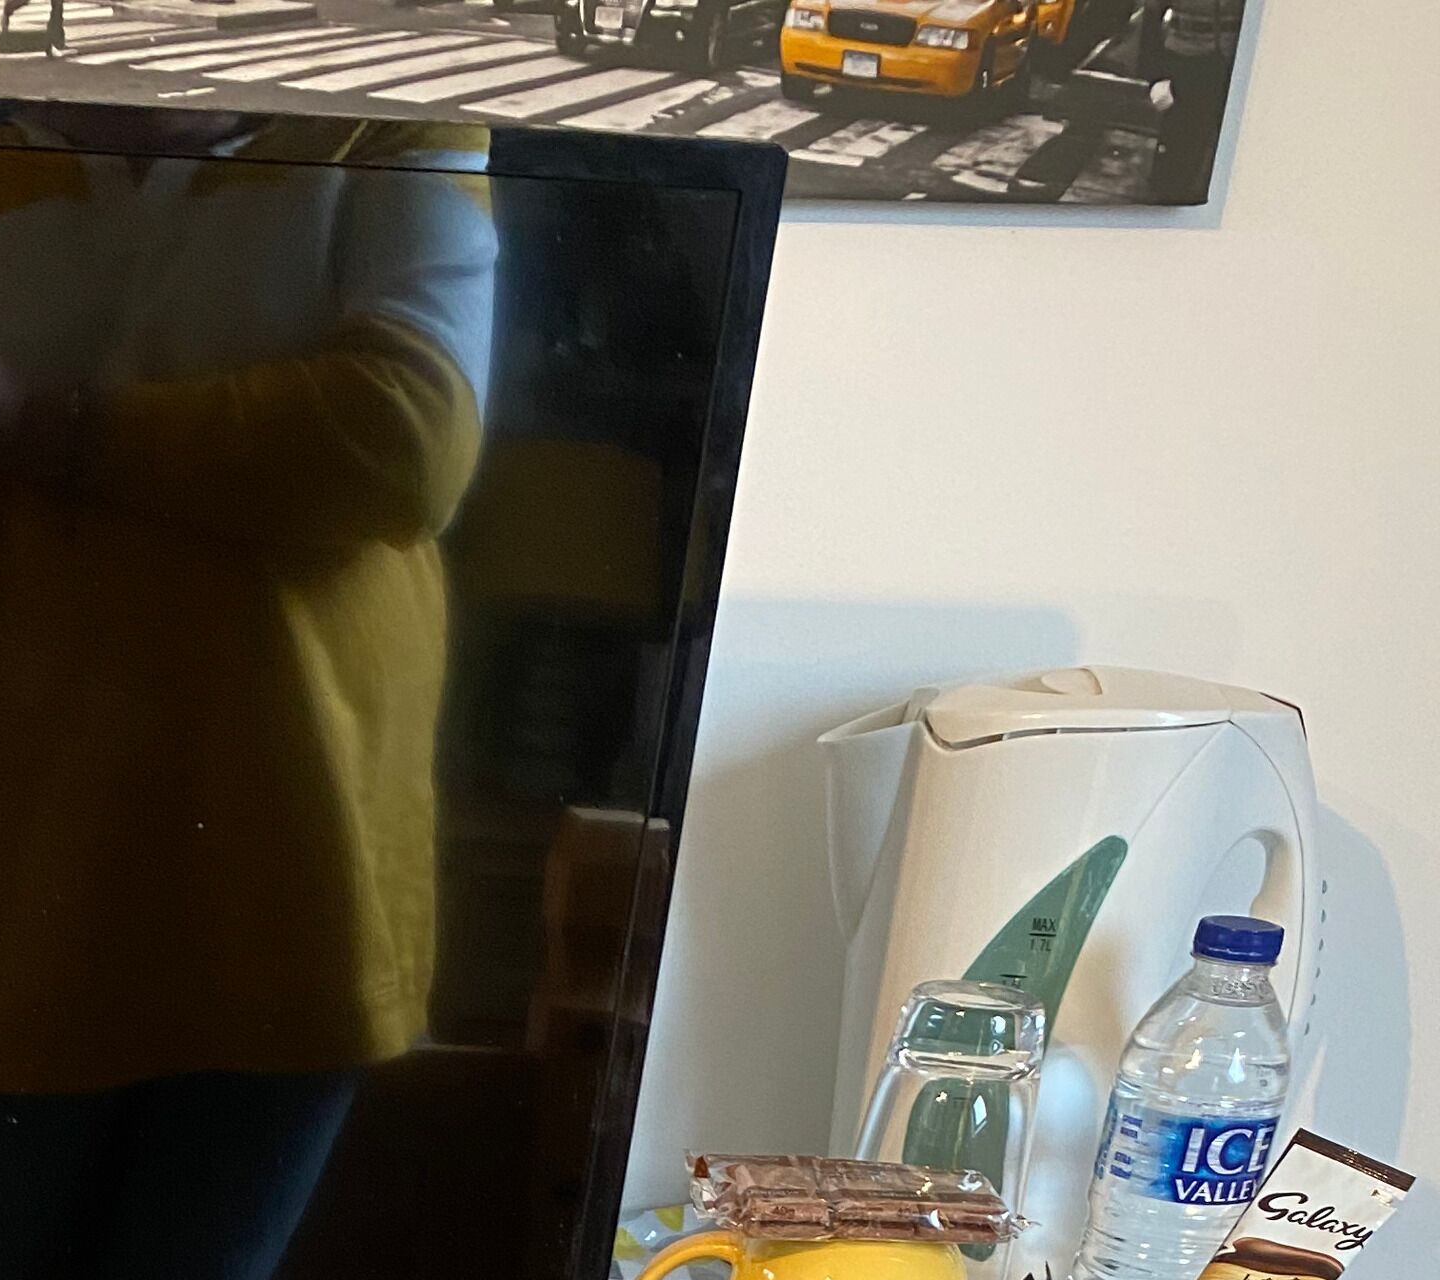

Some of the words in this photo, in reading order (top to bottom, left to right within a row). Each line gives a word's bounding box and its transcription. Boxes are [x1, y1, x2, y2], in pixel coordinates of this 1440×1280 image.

[1032, 917, 1057, 932] MAX
[1181, 1125, 1274, 1175] ICE
[1257, 1192, 1374, 1251] Galaxy
